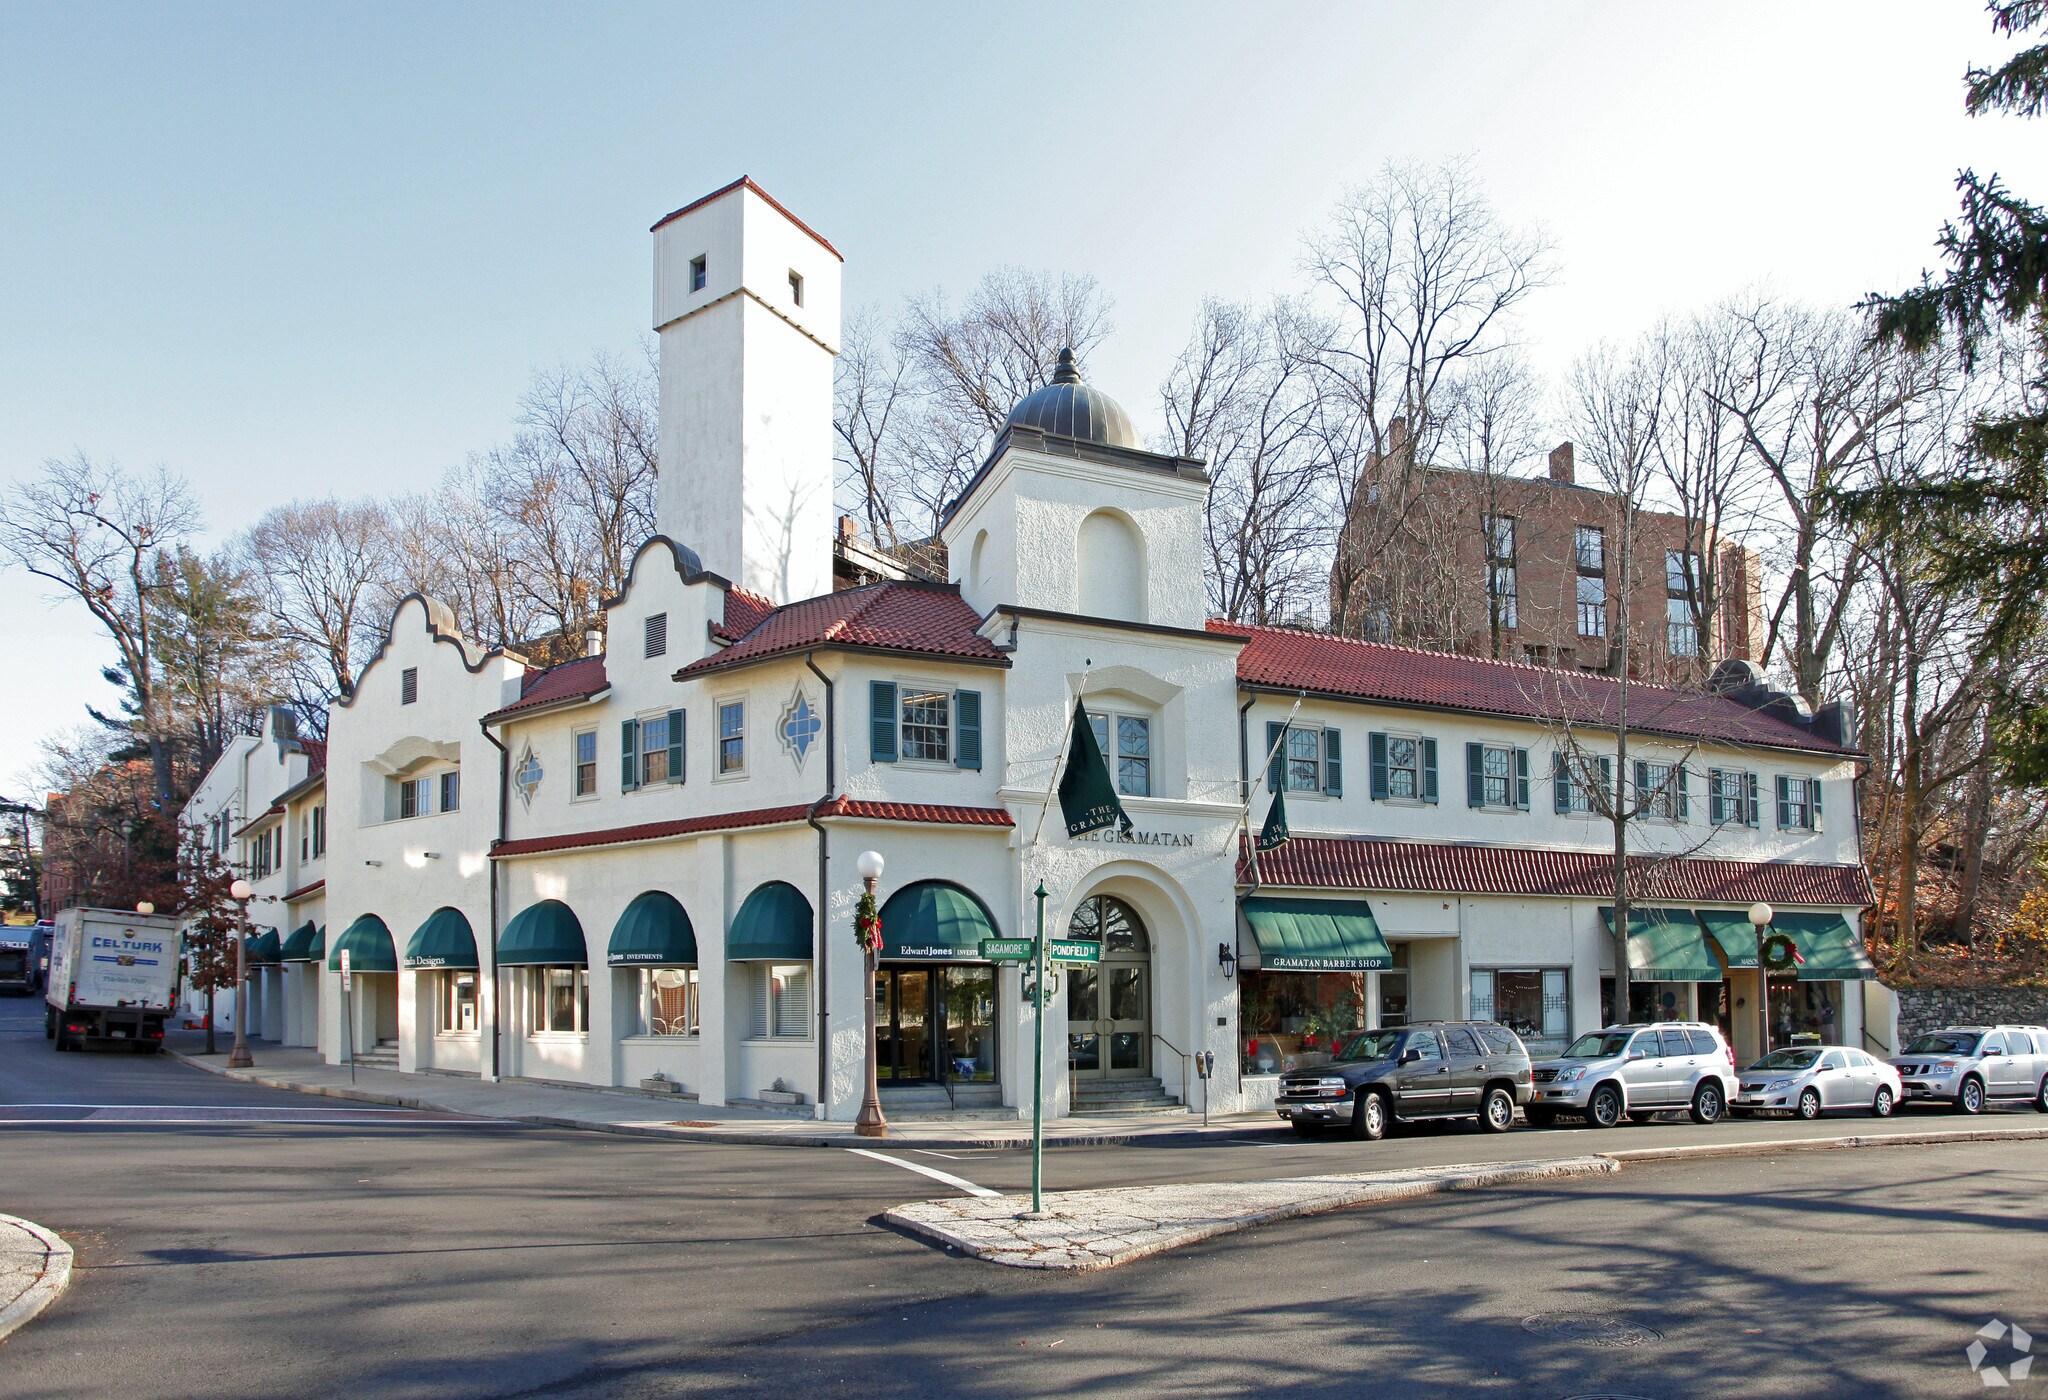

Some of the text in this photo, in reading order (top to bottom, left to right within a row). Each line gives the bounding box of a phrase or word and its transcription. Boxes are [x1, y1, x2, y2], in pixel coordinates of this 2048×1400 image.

[92, 937, 162, 953] CELTURK
[986, 943, 1023, 954] SAGAMORE
[1052, 944, 1089, 957] PONDFIELD
[416, 955, 446, 967] Designs
[1273, 958, 1382, 968] GRAMATAN BARBER SHOP
